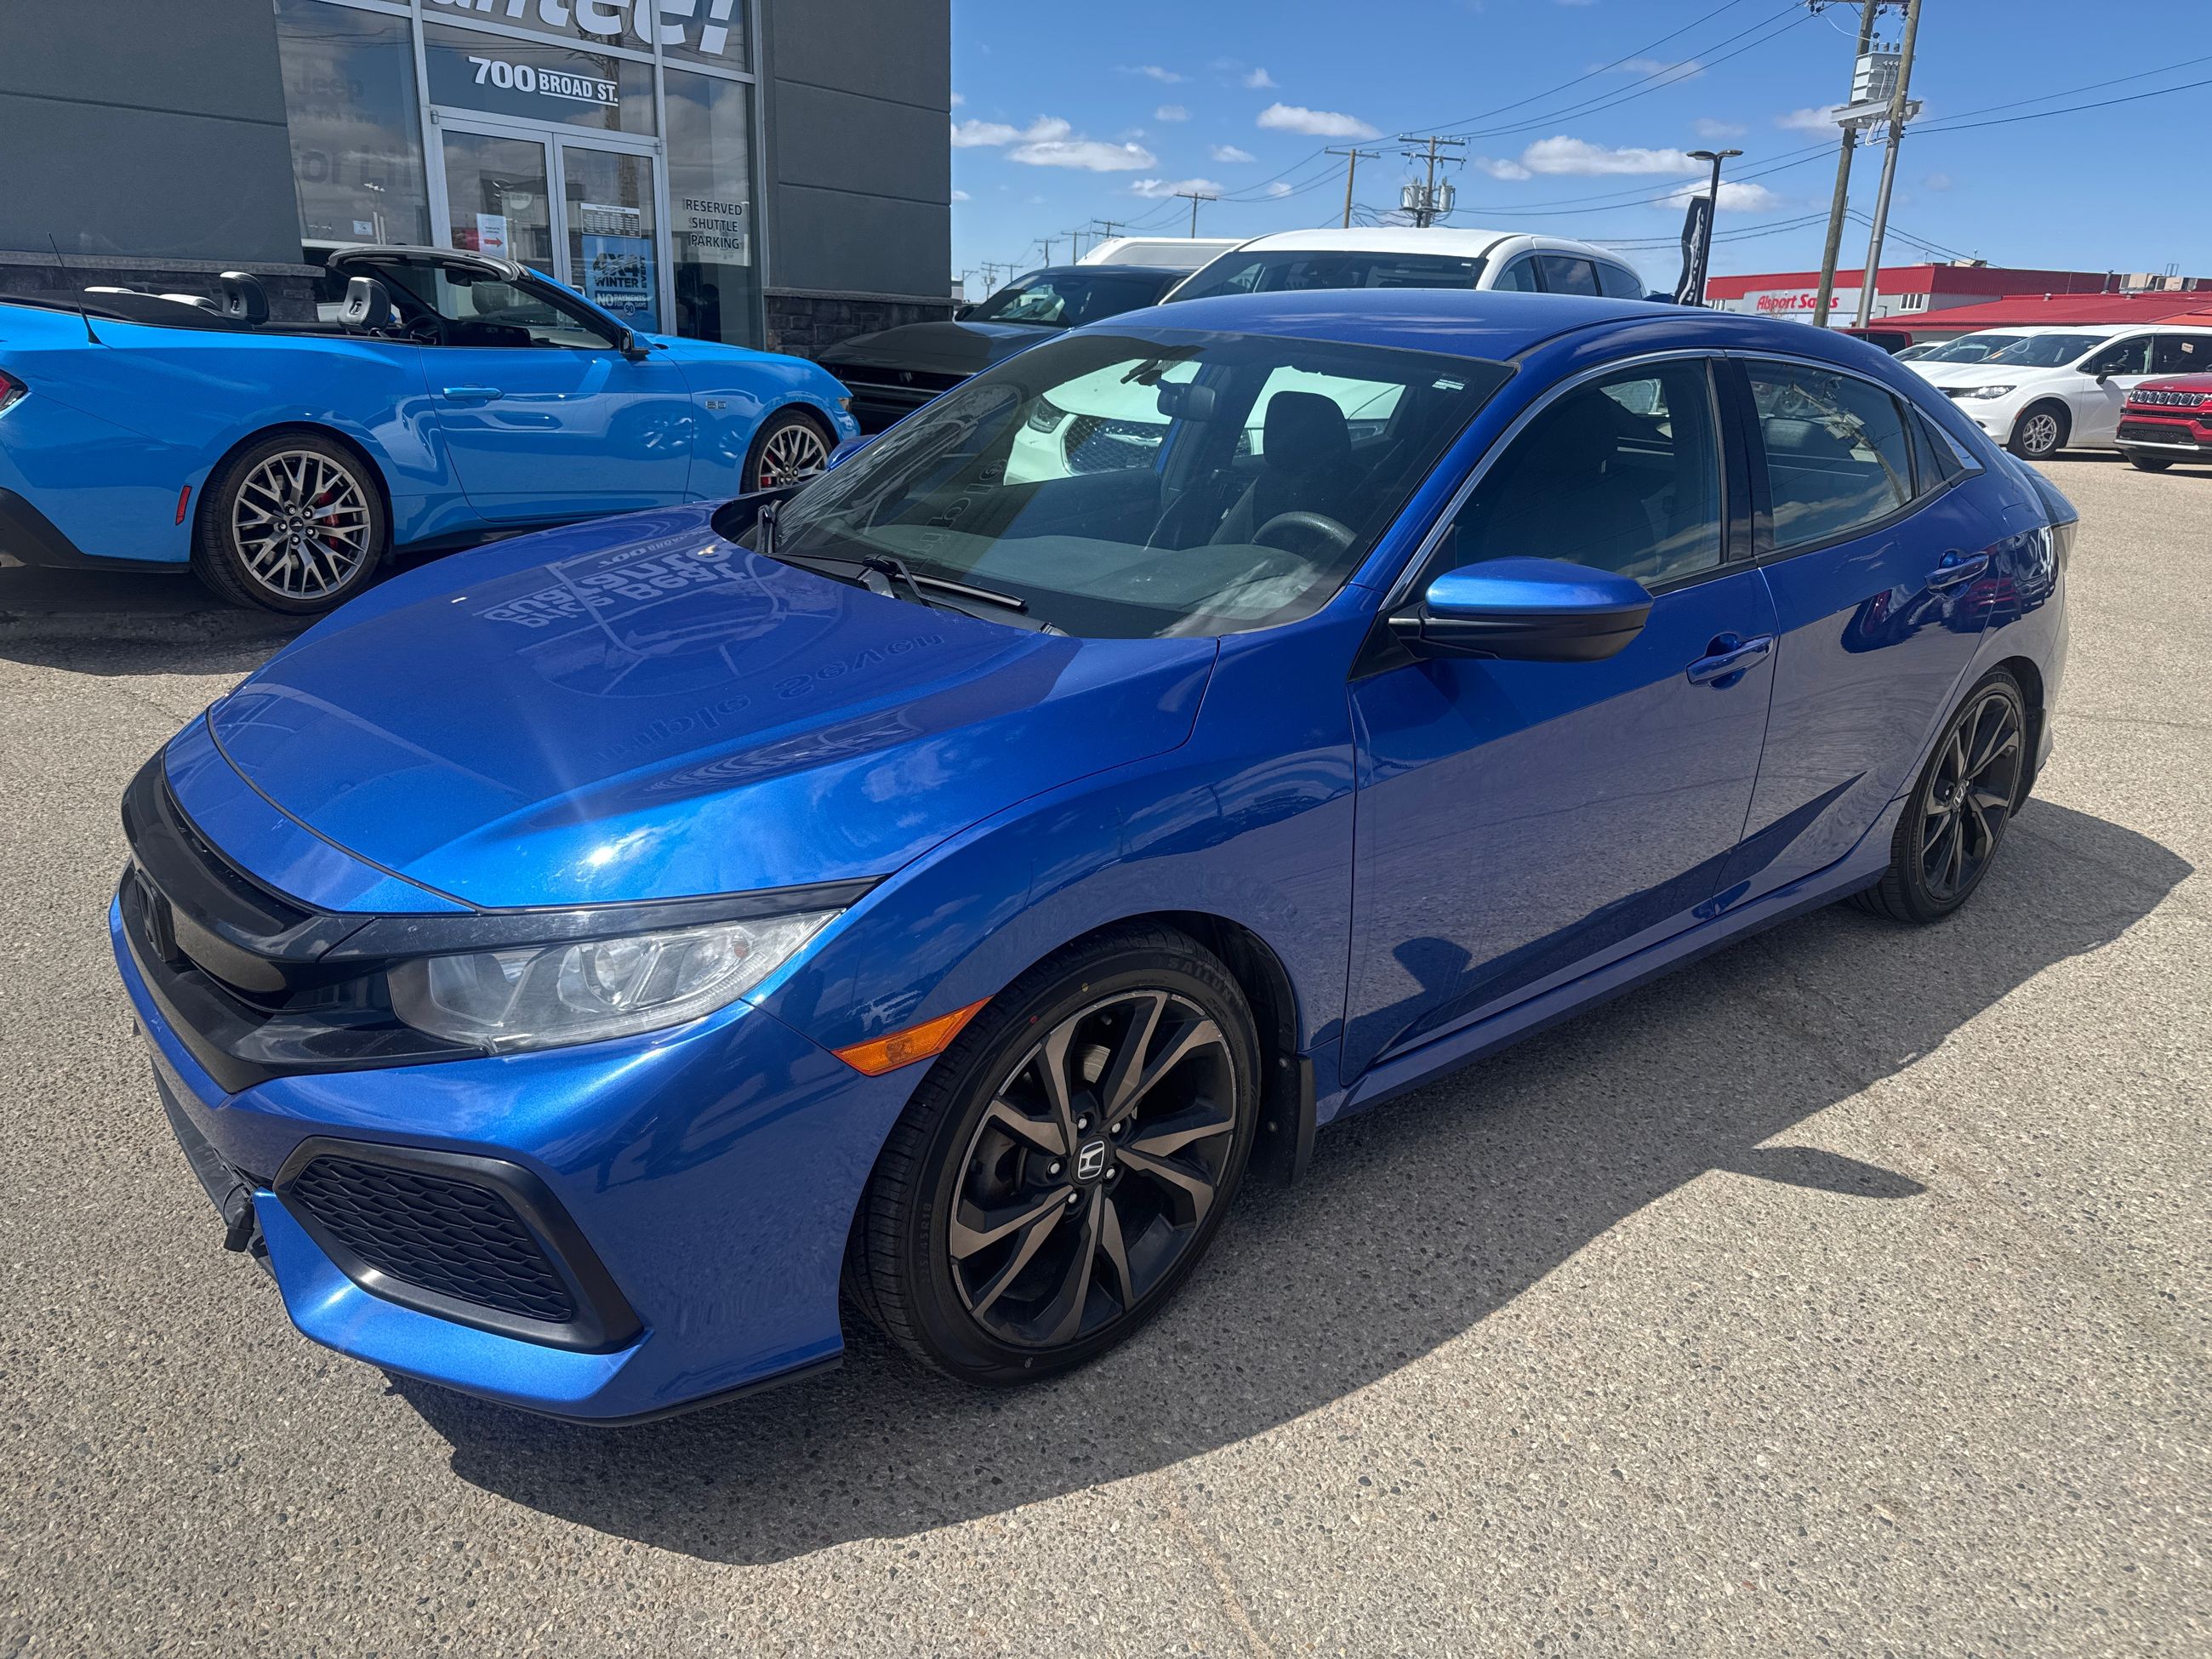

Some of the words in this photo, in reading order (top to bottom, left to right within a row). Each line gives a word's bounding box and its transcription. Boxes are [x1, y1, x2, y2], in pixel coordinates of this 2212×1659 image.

[468, 56, 536, 93] 700
[539, 73, 593, 99] BROAD
[597, 83, 619, 102] ST.
[685, 198, 743, 216] RESERVED
[692, 217, 738, 232] SHUTTLE
[691, 234, 739, 249] PARKING
[595, 276, 639, 288] WINTER
[596, 293, 613, 306] NO
[614, 294, 647, 302] PAYMENTS
[1799, 294, 1839, 309] Sas
[624, 304, 635, 314] 90
